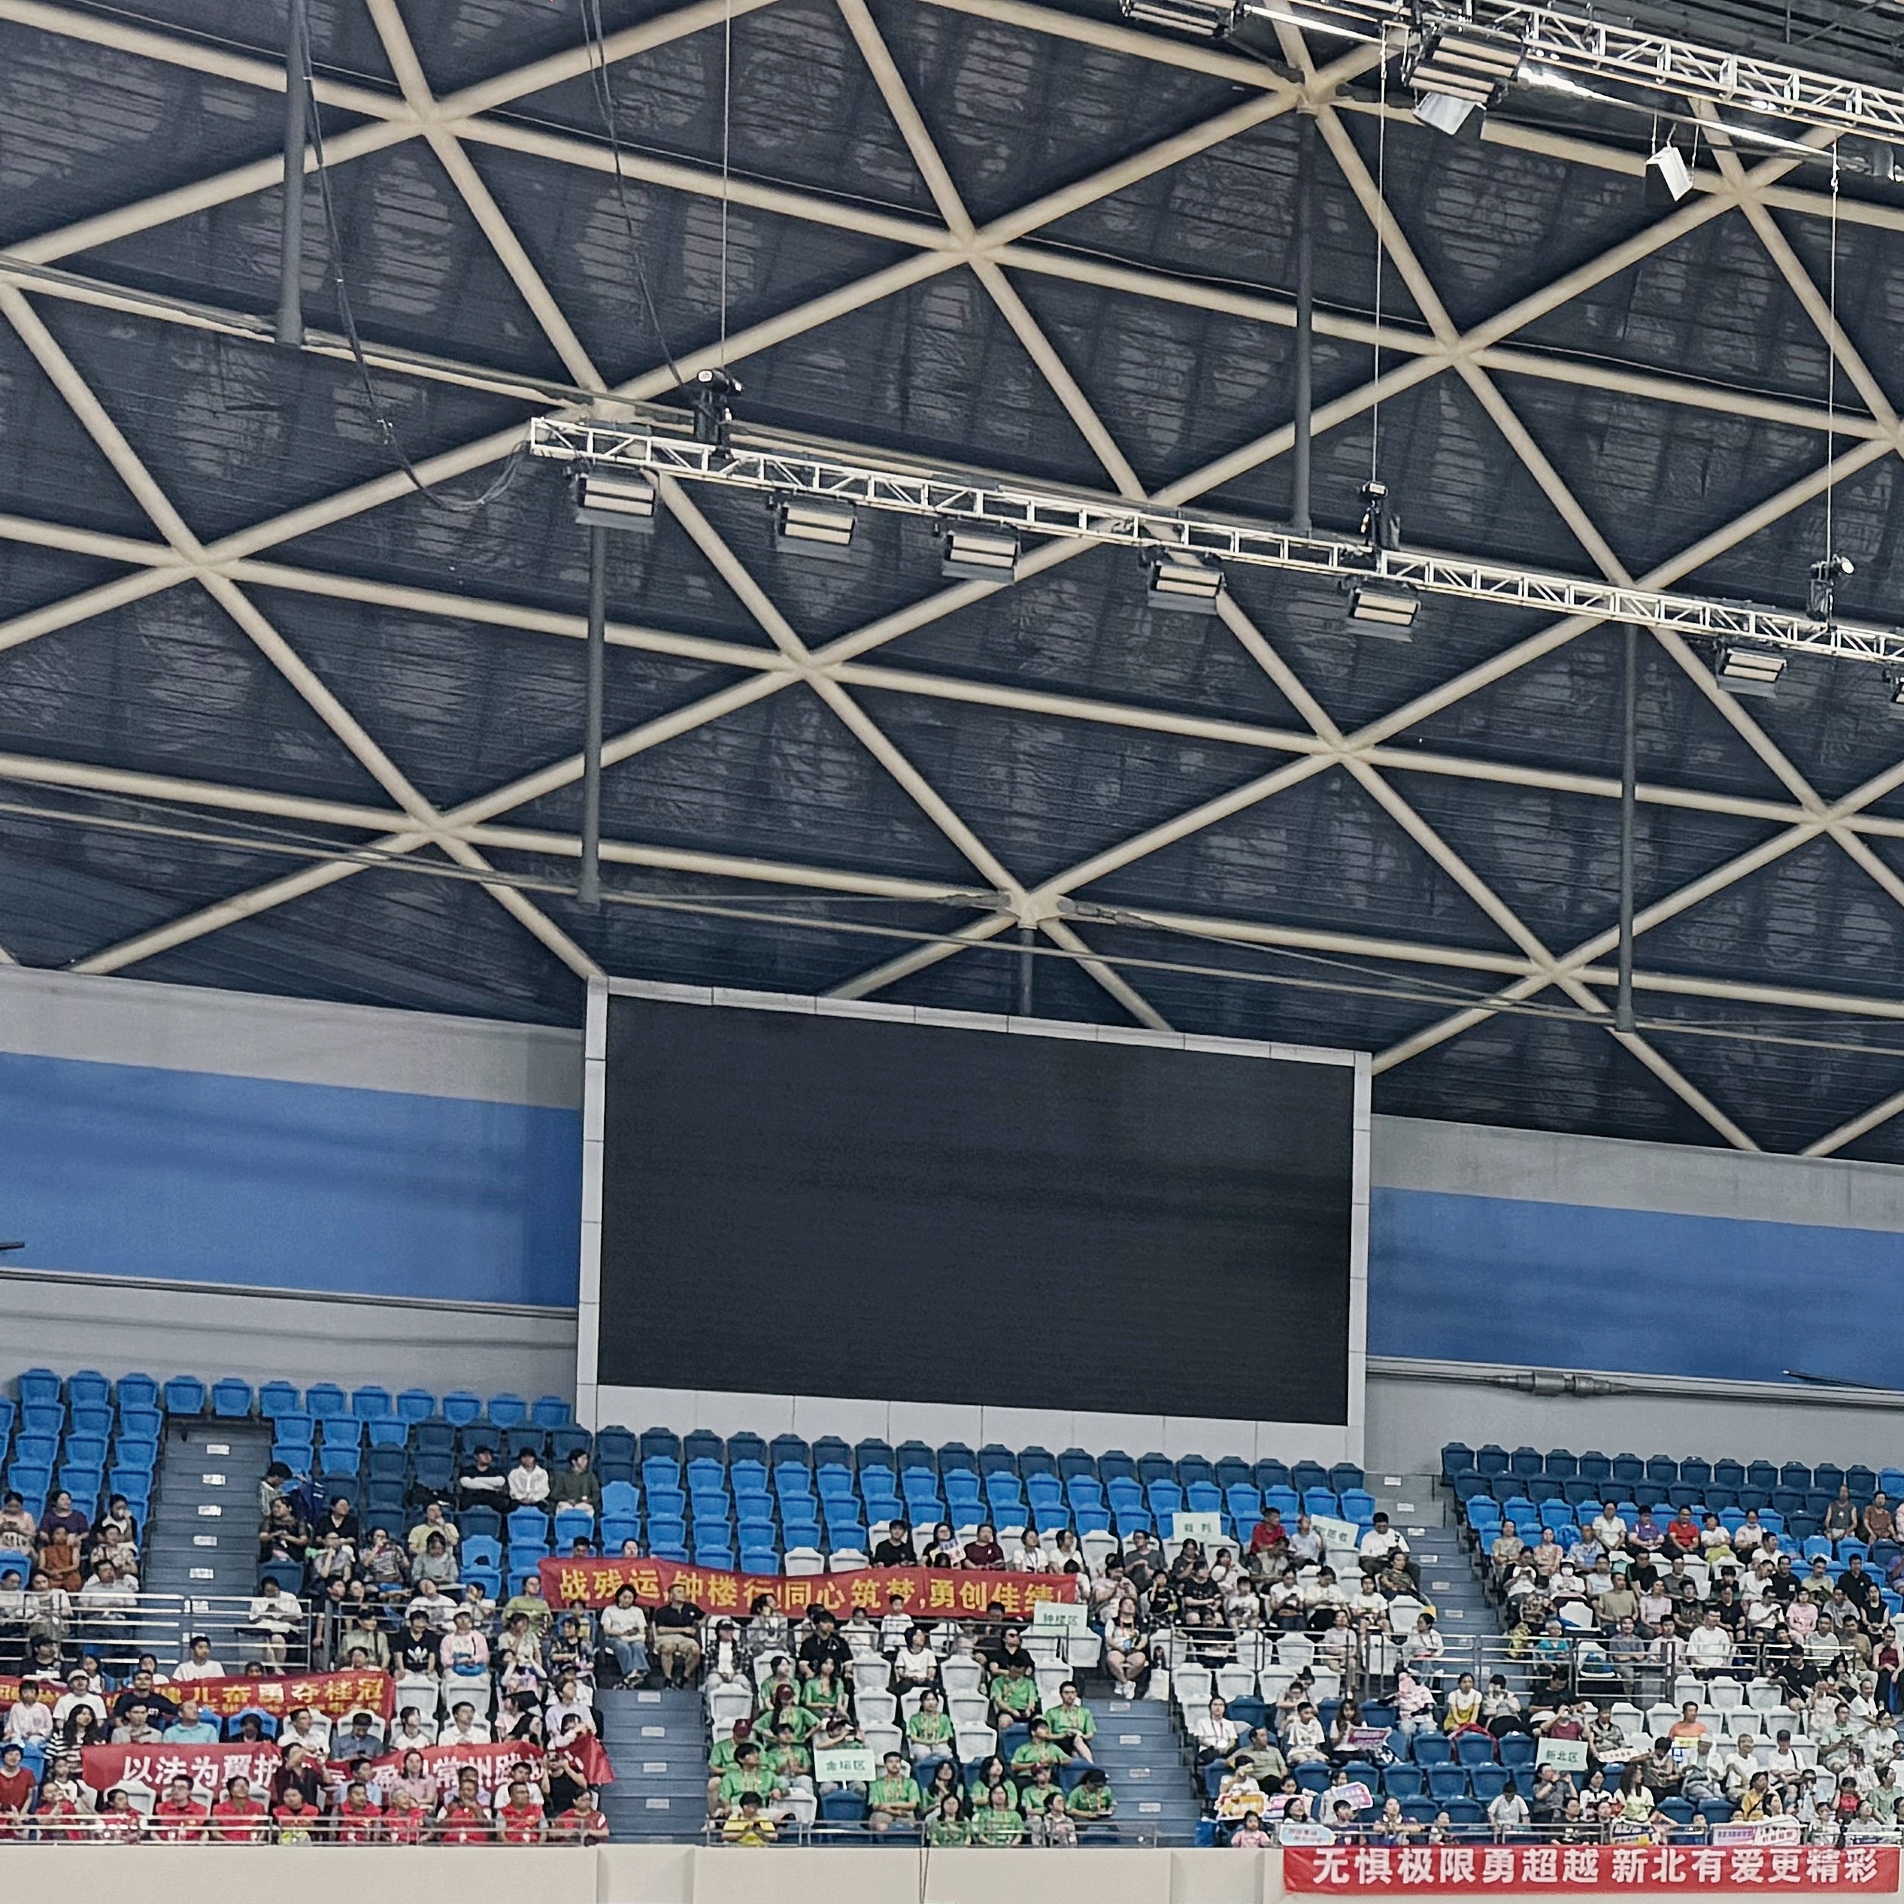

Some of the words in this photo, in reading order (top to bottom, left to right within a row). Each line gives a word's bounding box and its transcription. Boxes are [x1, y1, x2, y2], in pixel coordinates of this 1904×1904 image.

[1546, 1749, 1579, 1763] 新北区
[1312, 1848, 1600, 1886] 无惧极限勇超越
[1611, 1848, 1880, 1886] 新北有爱更精彩
